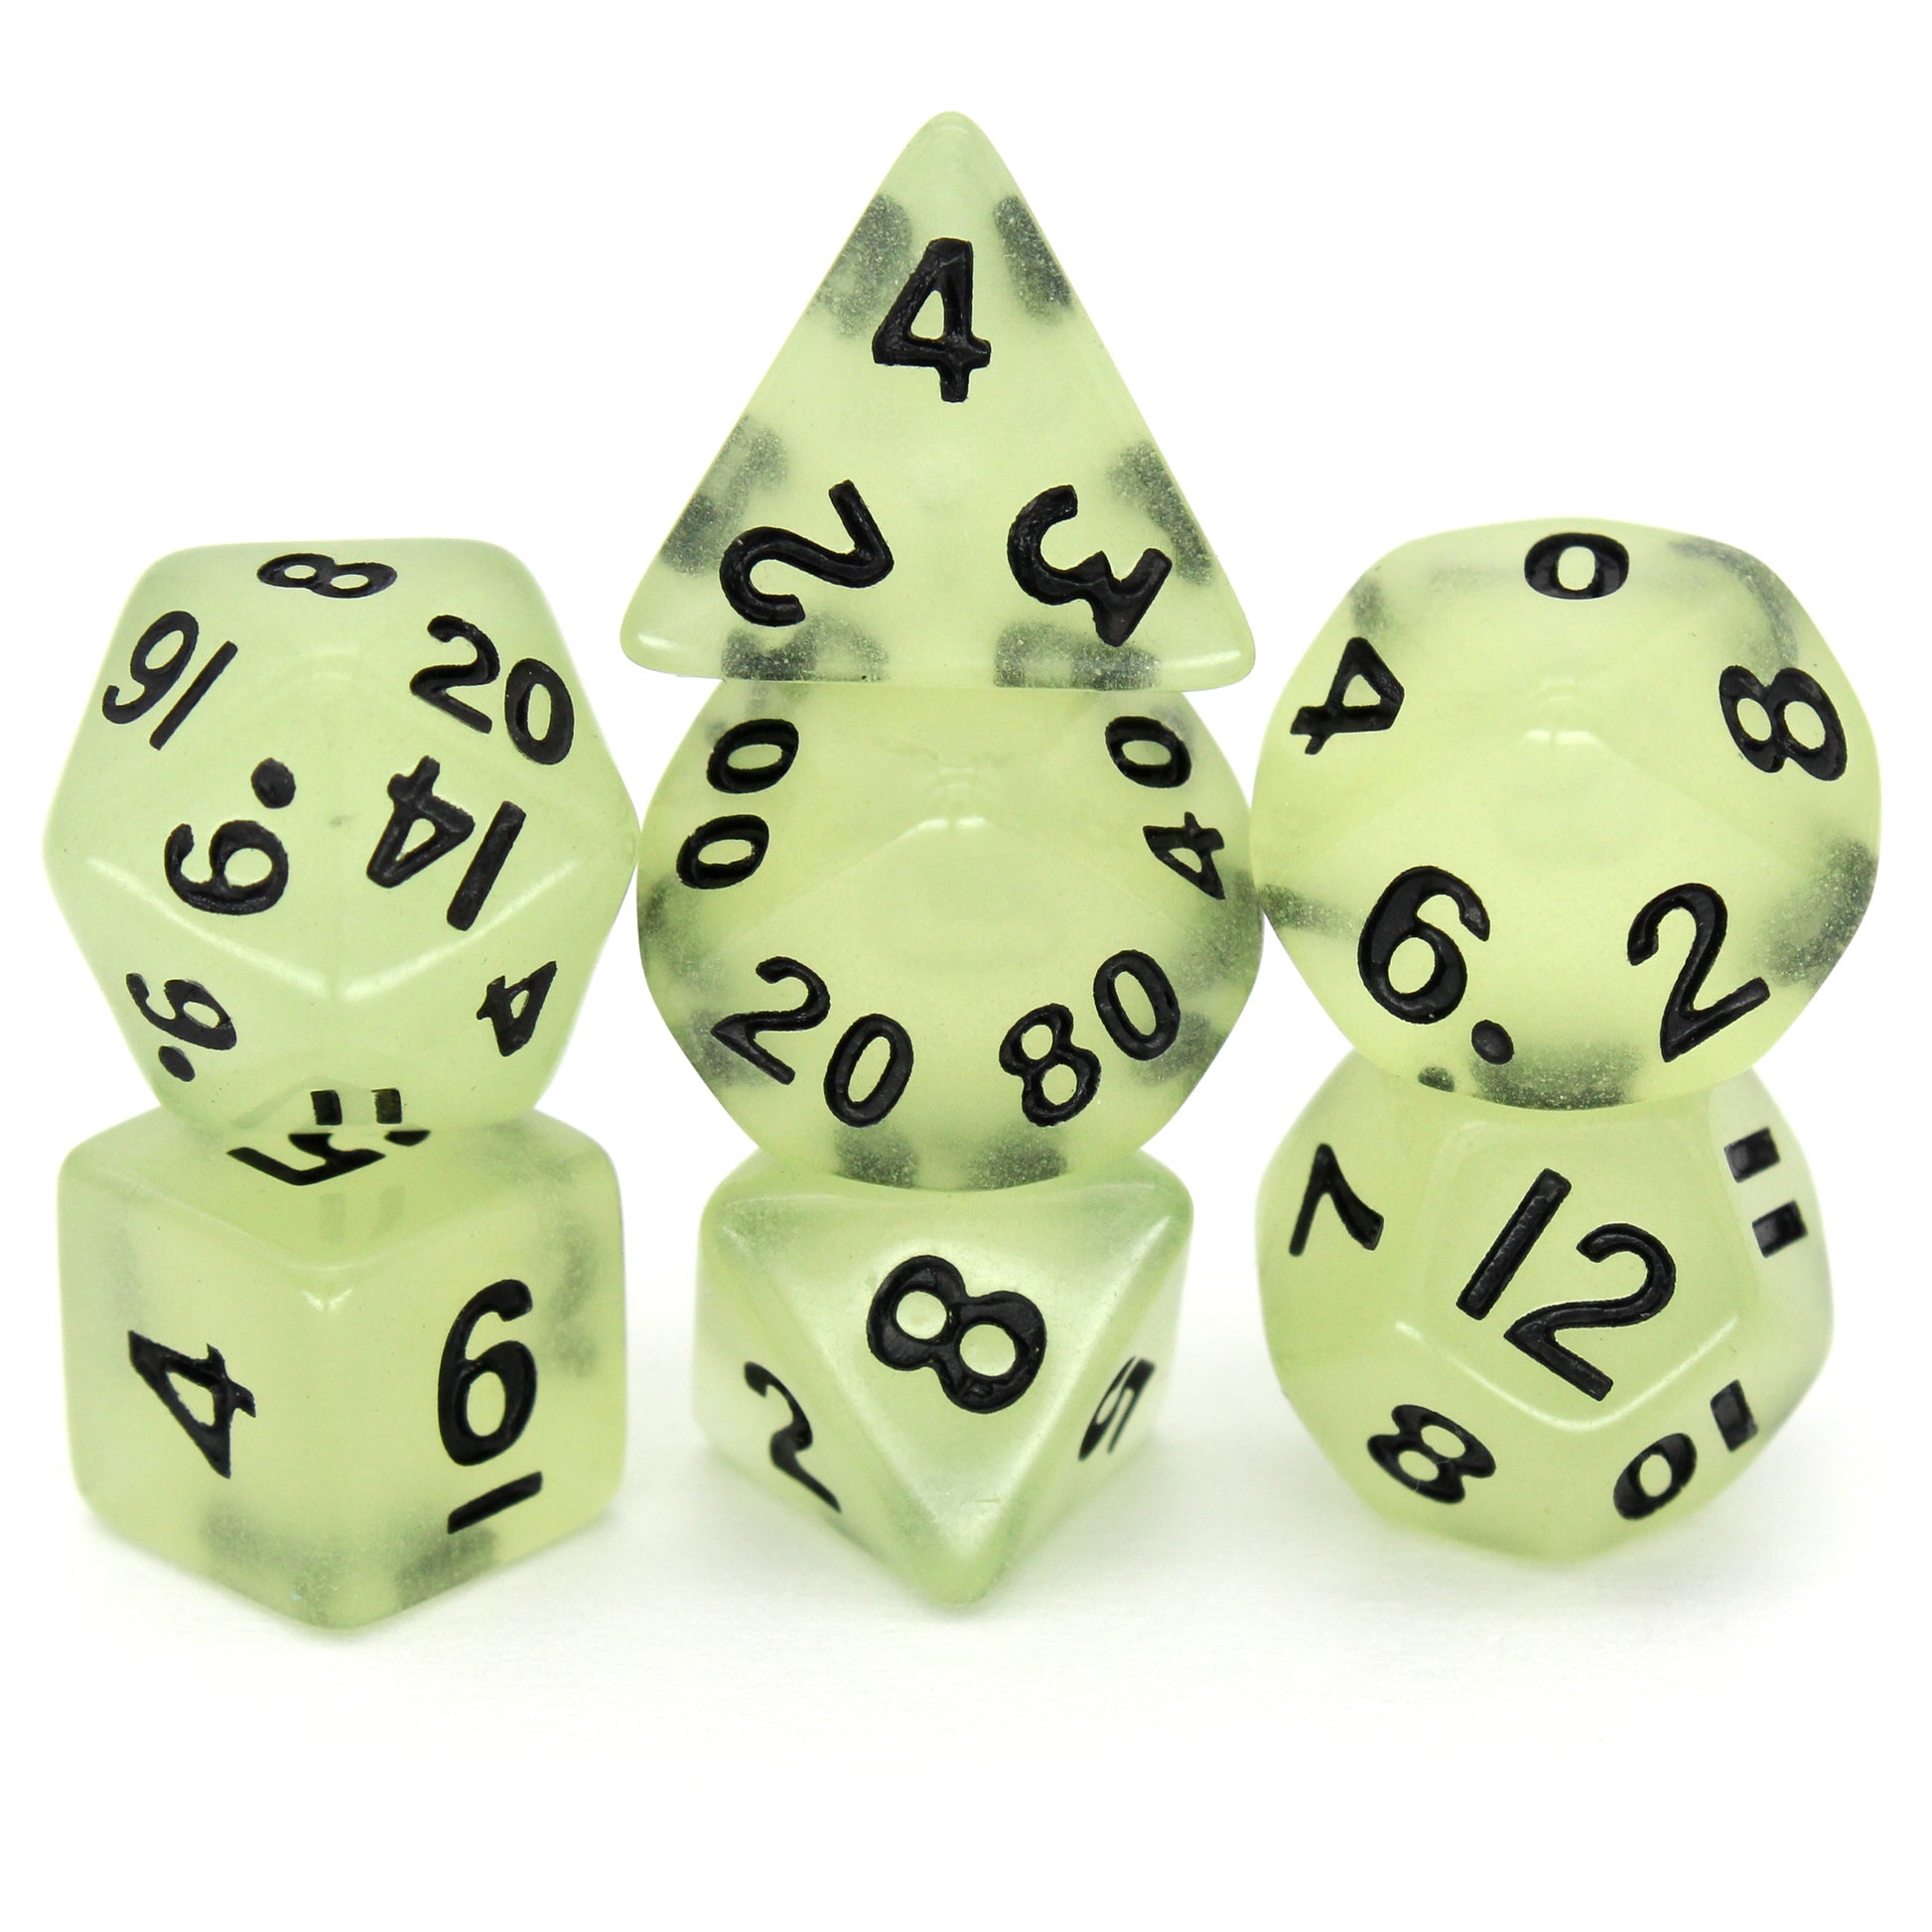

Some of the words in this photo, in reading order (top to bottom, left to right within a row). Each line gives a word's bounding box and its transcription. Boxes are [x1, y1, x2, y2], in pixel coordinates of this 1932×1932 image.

[872, 237, 992, 403] 4
[257, 553, 397, 599] 8
[719, 480, 895, 627] 2
[1007, 484, 1173, 648] 3
[1524, 533, 1629, 600] 0
[102, 611, 238, 751] 16
[409, 614, 575, 765] 20
[1290, 636, 1405, 755] 4
[1719, 665, 1848, 781] 8
[367, 756, 527, 931] 14
[676, 718, 799, 890] 00
[1105, 716, 1226, 900] 40
[476, 961, 558, 1057] 4
[710, 956, 914, 1128] 20
[999, 949, 1181, 1128] 80
[1627, 883, 1770, 1063] 2
[1290, 1143, 1384, 1256] 7
[866, 1255, 1047, 1415] 8
[1455, 1168, 1678, 1403] 12
[128, 1330, 256, 1479] 4
[743, 1361, 841, 1513] 2
[1078, 1355, 1156, 1461] 5
[1366, 1403, 1497, 1504] 8
[1613, 1379, 1757, 1520] 10
